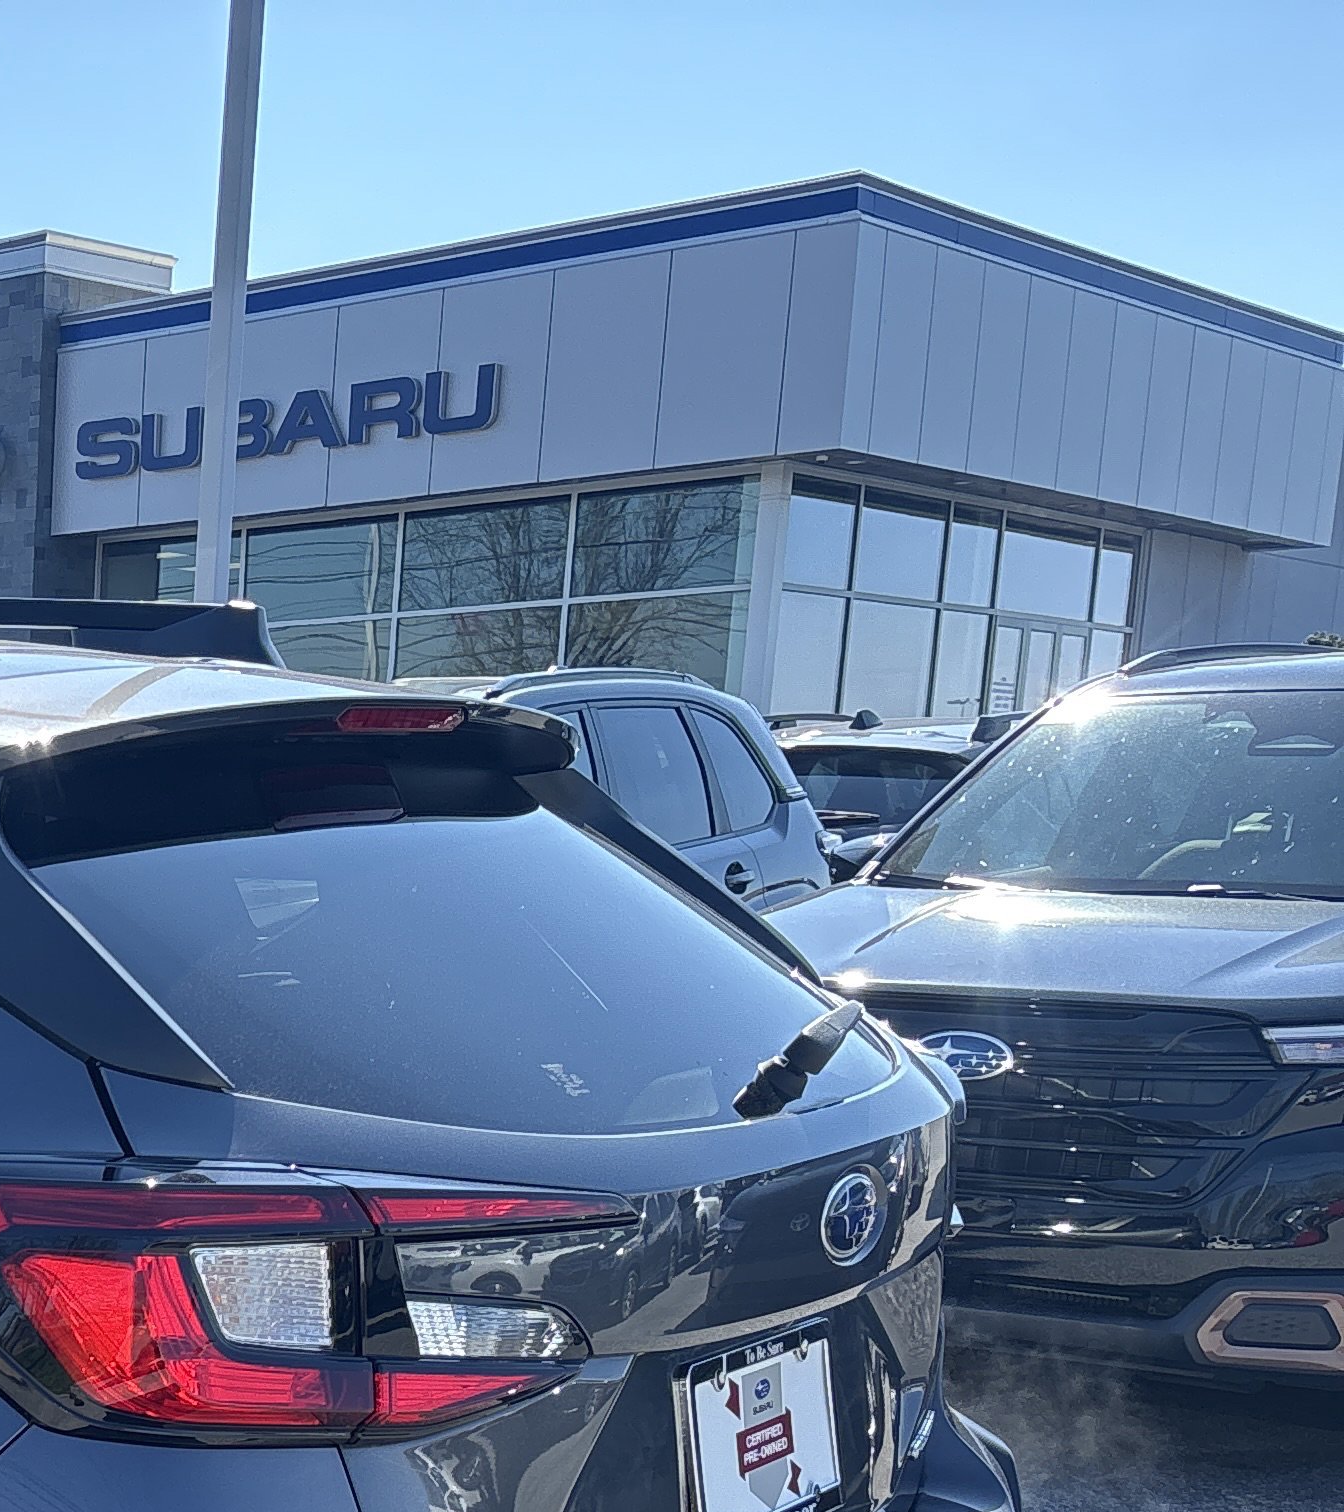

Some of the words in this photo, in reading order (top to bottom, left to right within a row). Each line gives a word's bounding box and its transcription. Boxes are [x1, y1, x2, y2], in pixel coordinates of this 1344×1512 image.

[74, 362, 503, 480] SUBARU
[744, 1348, 755, 1364] To
[756, 1345, 766, 1359] Be
[767, 1341, 784, 1356] Sure
[746, 1423, 784, 1448] CERTIFIED
[743, 1437, 788, 1466] PRE-OWNED
